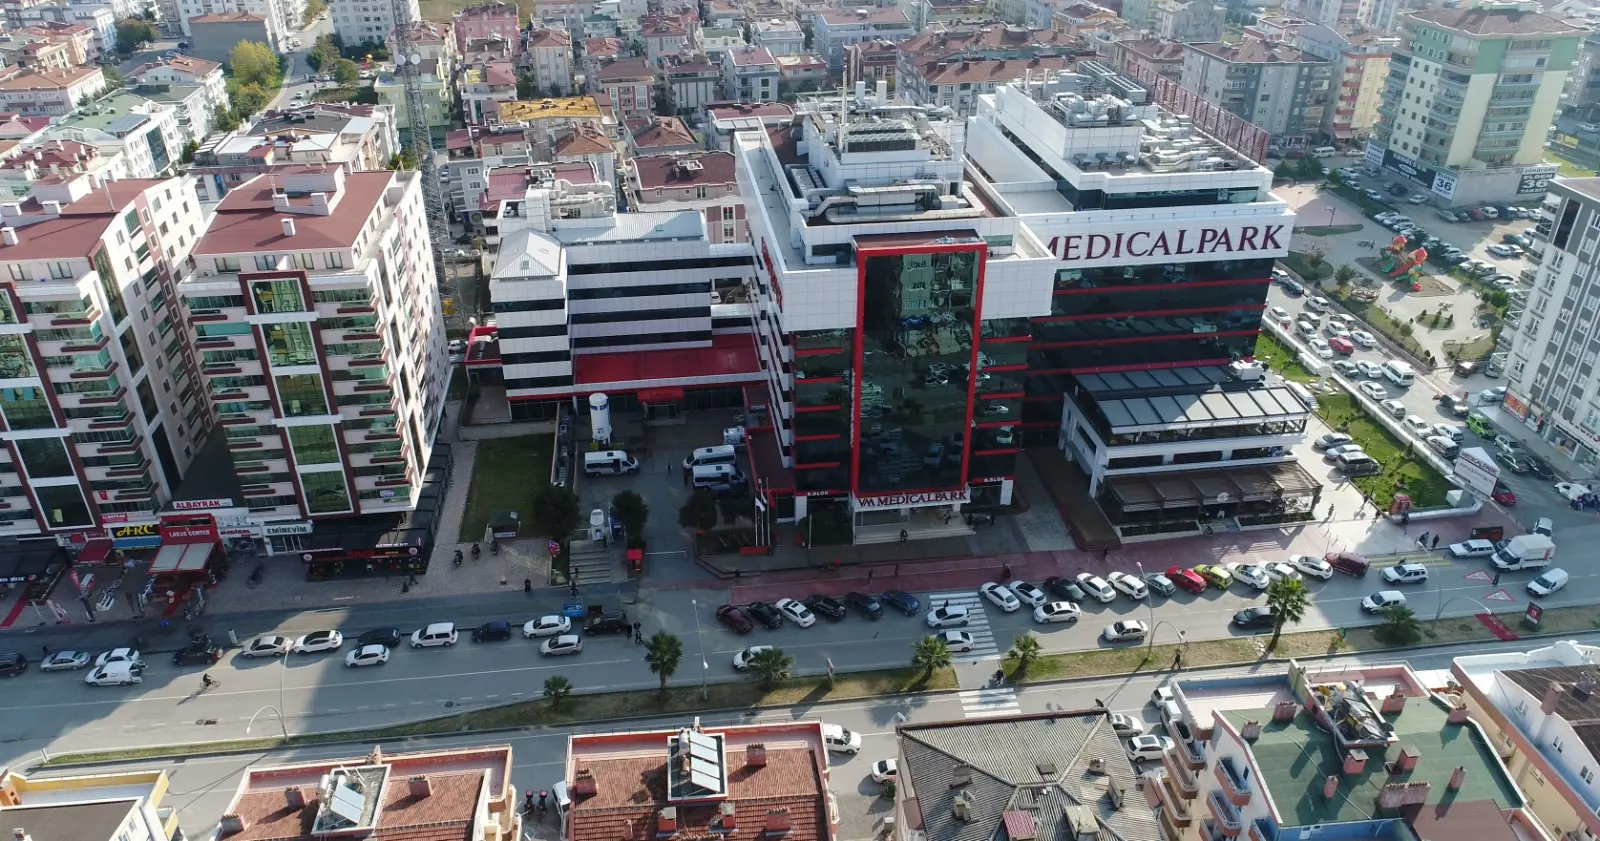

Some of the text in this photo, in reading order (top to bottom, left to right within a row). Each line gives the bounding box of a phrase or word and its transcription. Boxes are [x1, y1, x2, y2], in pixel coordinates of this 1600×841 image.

[1436, 178, 1452, 191] 36
[1522, 180, 1549, 188] 36
[876, 490, 967, 506] MEDICALPARK
[176, 500, 220, 508] ALBAYRAK
[116, 524, 154, 536] ARC
[267, 525, 307, 534] EMİNEVİM
